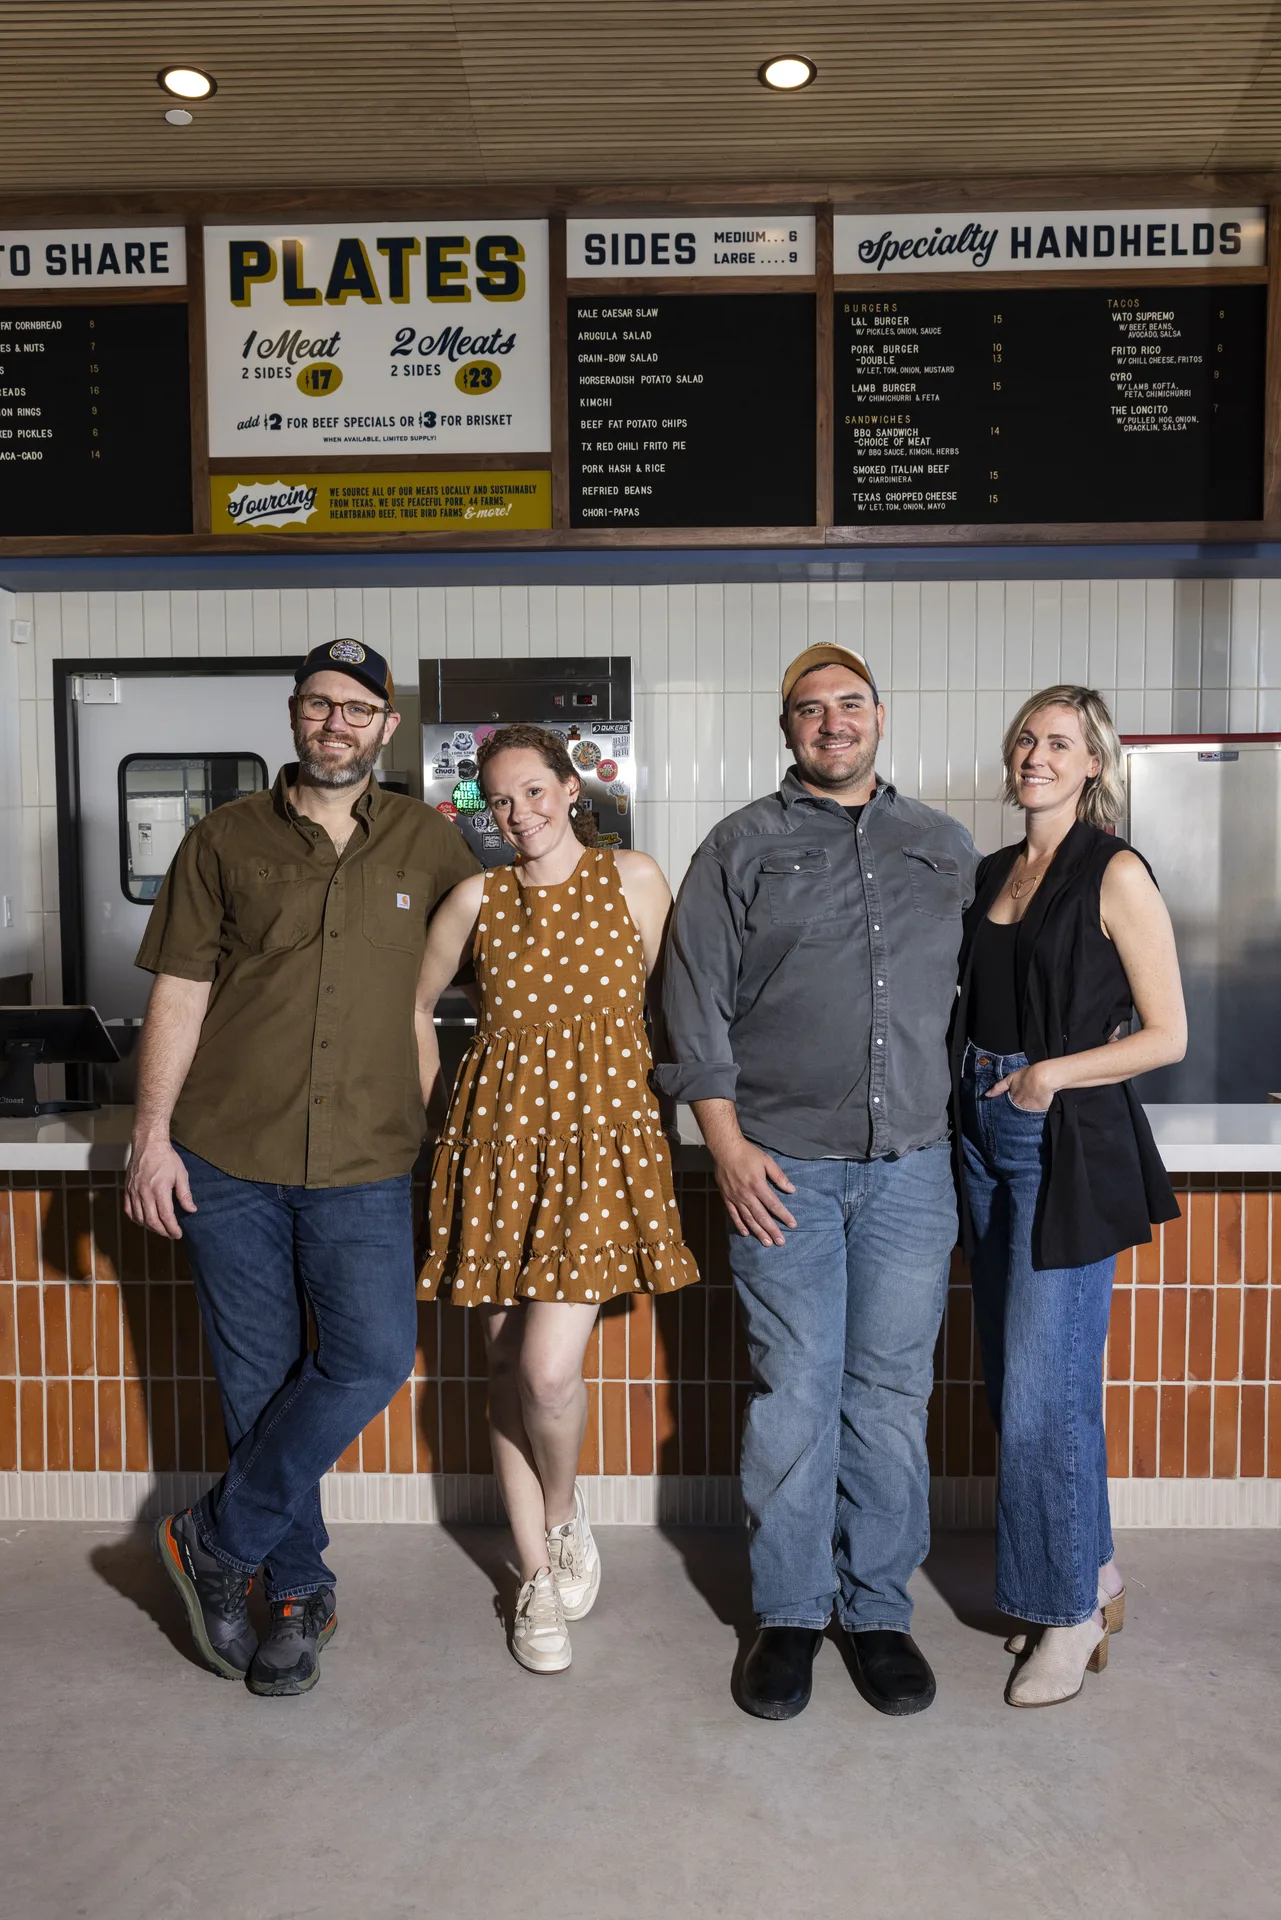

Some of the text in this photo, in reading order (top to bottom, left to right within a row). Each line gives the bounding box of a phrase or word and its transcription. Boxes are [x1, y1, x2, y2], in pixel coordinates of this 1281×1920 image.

[788, 230, 798, 242] 6
[584, 232, 696, 266] SIDES
[858, 222, 1242, 271] Specialty HANDHELDS
[45, 241, 170, 276] SHARE
[714, 251, 798, 264] LARGE 9
[229, 235, 526, 307] PLATES
[844, 304, 898, 313] BURGERS
[1107, 299, 1140, 308] TACOS
[577, 308, 659, 318] KALE CAESAR SLAW
[1112, 312, 1175, 321] VATO SUPREMO
[0, 320, 95, 330] FAT CORNBREAD 8
[851, 315, 1002, 326] L&L BURGER 15
[920, 327, 942, 335] SAUCE
[1149, 323, 1174, 331] BEANS,
[578, 331, 652, 341] ARUGULA SALAD
[1160, 330, 1181, 338] SALSA
[23, 342, 96, 352] NUTS 7
[242, 329, 341, 366] 1 Meat
[390, 326, 517, 363] 2 Meats
[851, 343, 1002, 354] PORK BURGER 10
[1111, 345, 1161, 355] FRITO RICO
[578, 353, 659, 363] GRAIN-BOW SALAD
[855, 354, 1002, 365] -DOUBLE 13
[1177, 355, 1203, 363] FRITOS
[89, 364, 99, 373] 15
[924, 365, 955, 374] MUSTARD
[242, 366, 332, 390] 2 SIDES $17
[390, 364, 493, 388] 2 SIDES $23
[579, 374, 704, 385] HORSERADISH POTATO SALAD
[1110, 372, 1132, 381] GYRO
[89, 386, 100, 395] 16
[851, 382, 1001, 393] LAMB BURGER 15
[580, 398, 613, 407] KIMCHI
[17, 406, 97, 416] RINGS 9
[1111, 405, 1168, 415] THE LONCITO
[237, 411, 512, 431] add $2 FOR BEEF SPECIALS OR $3 FOR BRISKET
[581, 419, 688, 429] BEEF FAT POTATO CHIPS
[845, 415, 911, 425] SANDWICHES
[1127, 416, 1156, 424] PULLED
[853, 427, 1000, 437] BBQ SANDWICH 14
[1162, 423, 1187, 431] SALSA
[17, 428, 98, 438] PICKLES 6
[581, 441, 687, 451] TX RED CHILI FRITO PIE
[854, 437, 931, 447] -CHOICE OF MEAT
[91, 450, 100, 459] 14
[883, 447, 959, 456] SAUCE, HERBS
[582, 463, 666, 474] PORK HASH & RICE
[852, 464, 999, 480] SMOKED ITALIAN BEEF 15
[329, 484, 537, 497] WE SOURCE ALL OF OUR MEATS LOCALLY AND SUSTAINABLY
[582, 486, 653, 496] REFRIED BEANS
[329, 499, 349, 508] FROM
[379, 498, 389, 507] WE
[392, 498, 404, 507] USE
[408, 497, 442, 507] PEACEFUL
[445, 497, 466, 507] PORK,
[469, 497, 478, 506] 44
[481, 496, 506, 506] FARMS,
[852, 491, 998, 503] TEXAS CHOPPED CHEESE 15
[227, 486, 318, 527] Sourcing
[330, 503, 513, 519] HEARTBRAND BEEF, TRUE BIRD FARMS more!
[927, 502, 946, 510] MAYO
[582, 508, 640, 517] CHORI-PAPAS
